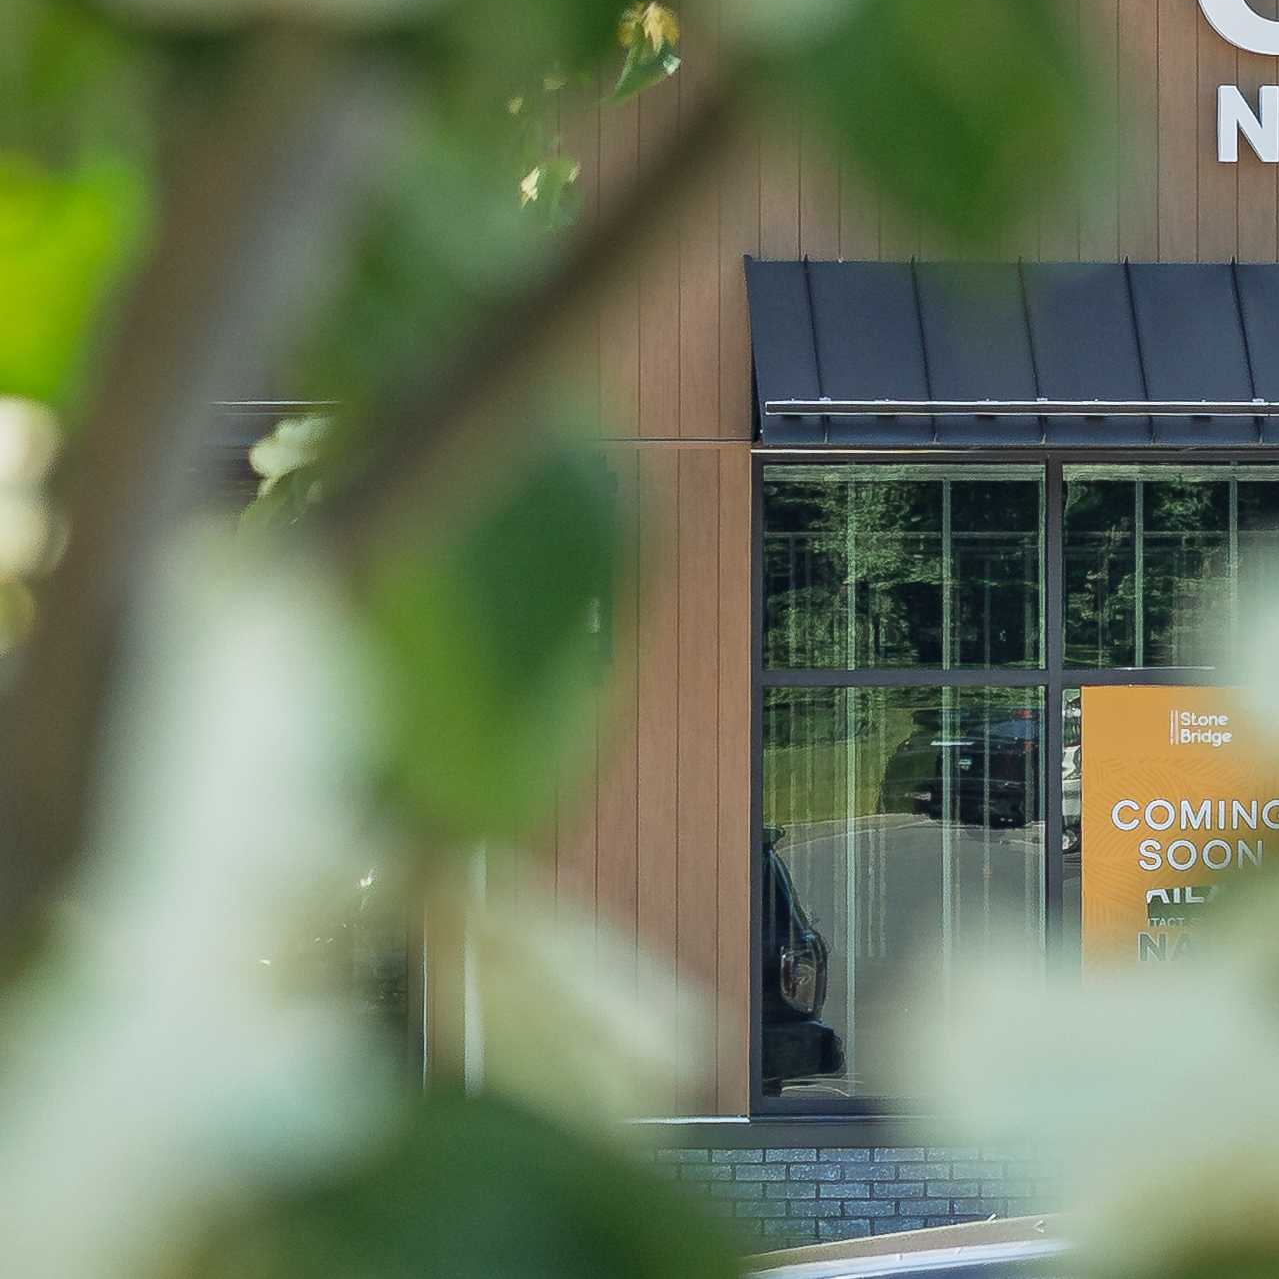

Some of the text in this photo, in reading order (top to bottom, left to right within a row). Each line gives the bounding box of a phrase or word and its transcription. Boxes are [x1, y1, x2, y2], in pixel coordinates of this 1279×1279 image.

[1180, 711, 1229, 727] Stone
[1180, 729, 1232, 747] Bridge
[1138, 839, 1263, 871] SOON
